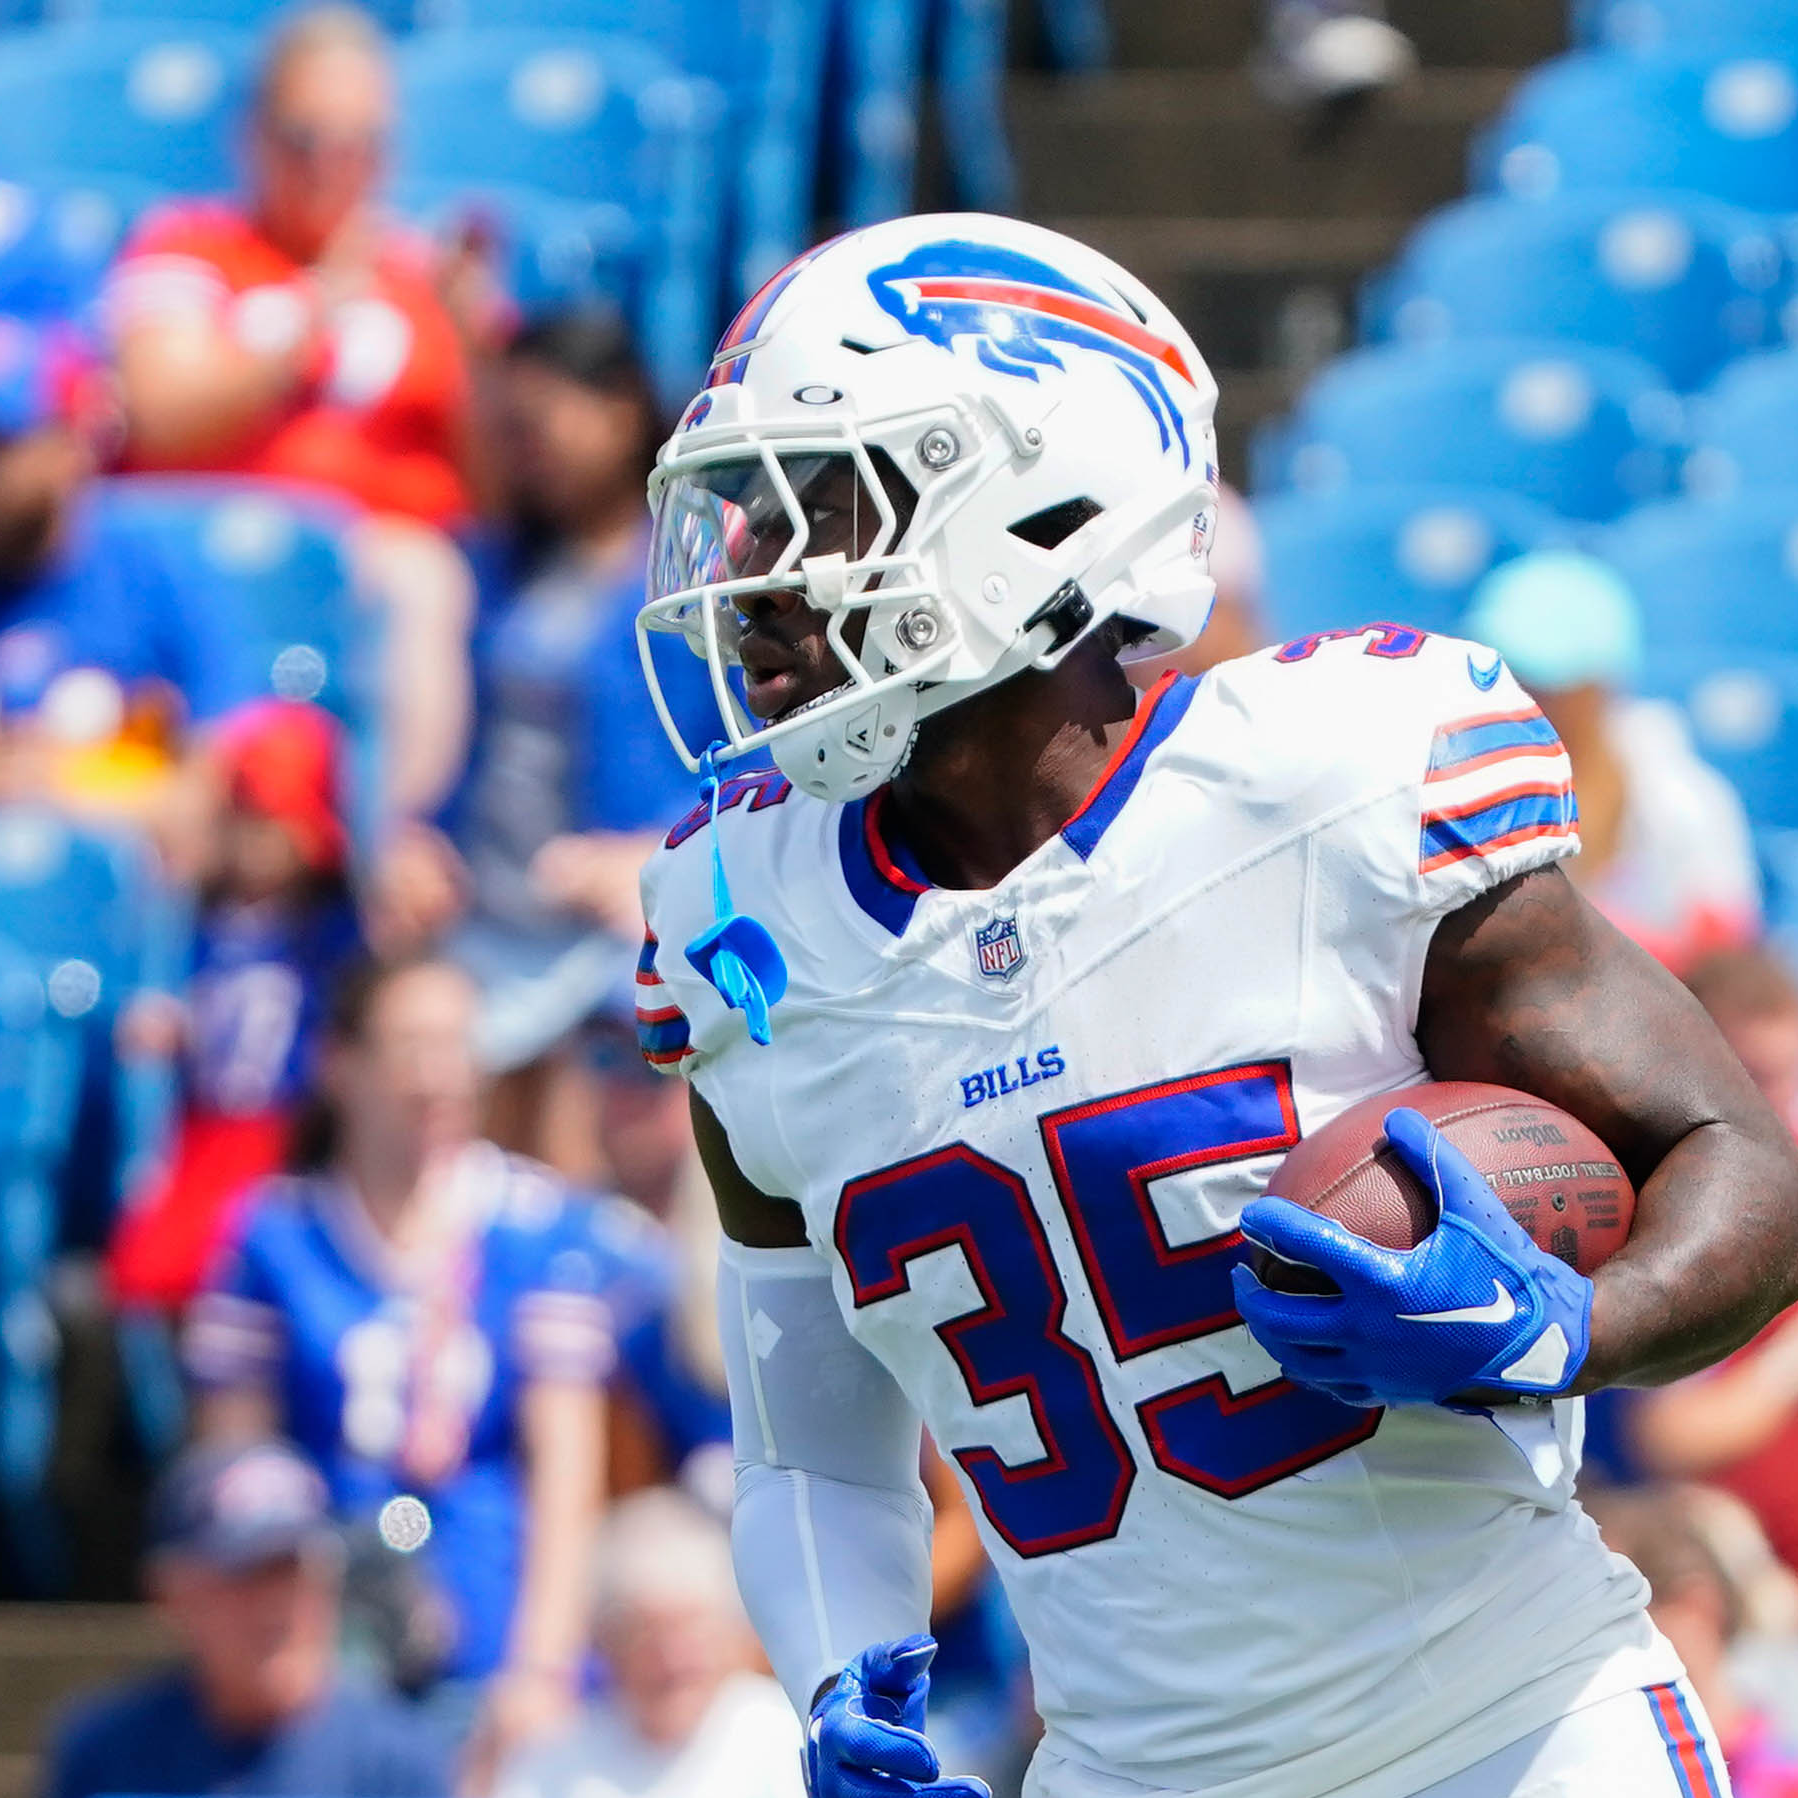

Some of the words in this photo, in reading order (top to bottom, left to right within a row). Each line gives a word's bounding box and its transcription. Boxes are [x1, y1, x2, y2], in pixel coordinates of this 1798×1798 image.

[982, 938, 1018, 971] NFL
[959, 1043, 1066, 1109] BILLS
[1504, 1164, 1578, 1187] FOOTBALL
[834, 1057, 1385, 1560] 35
